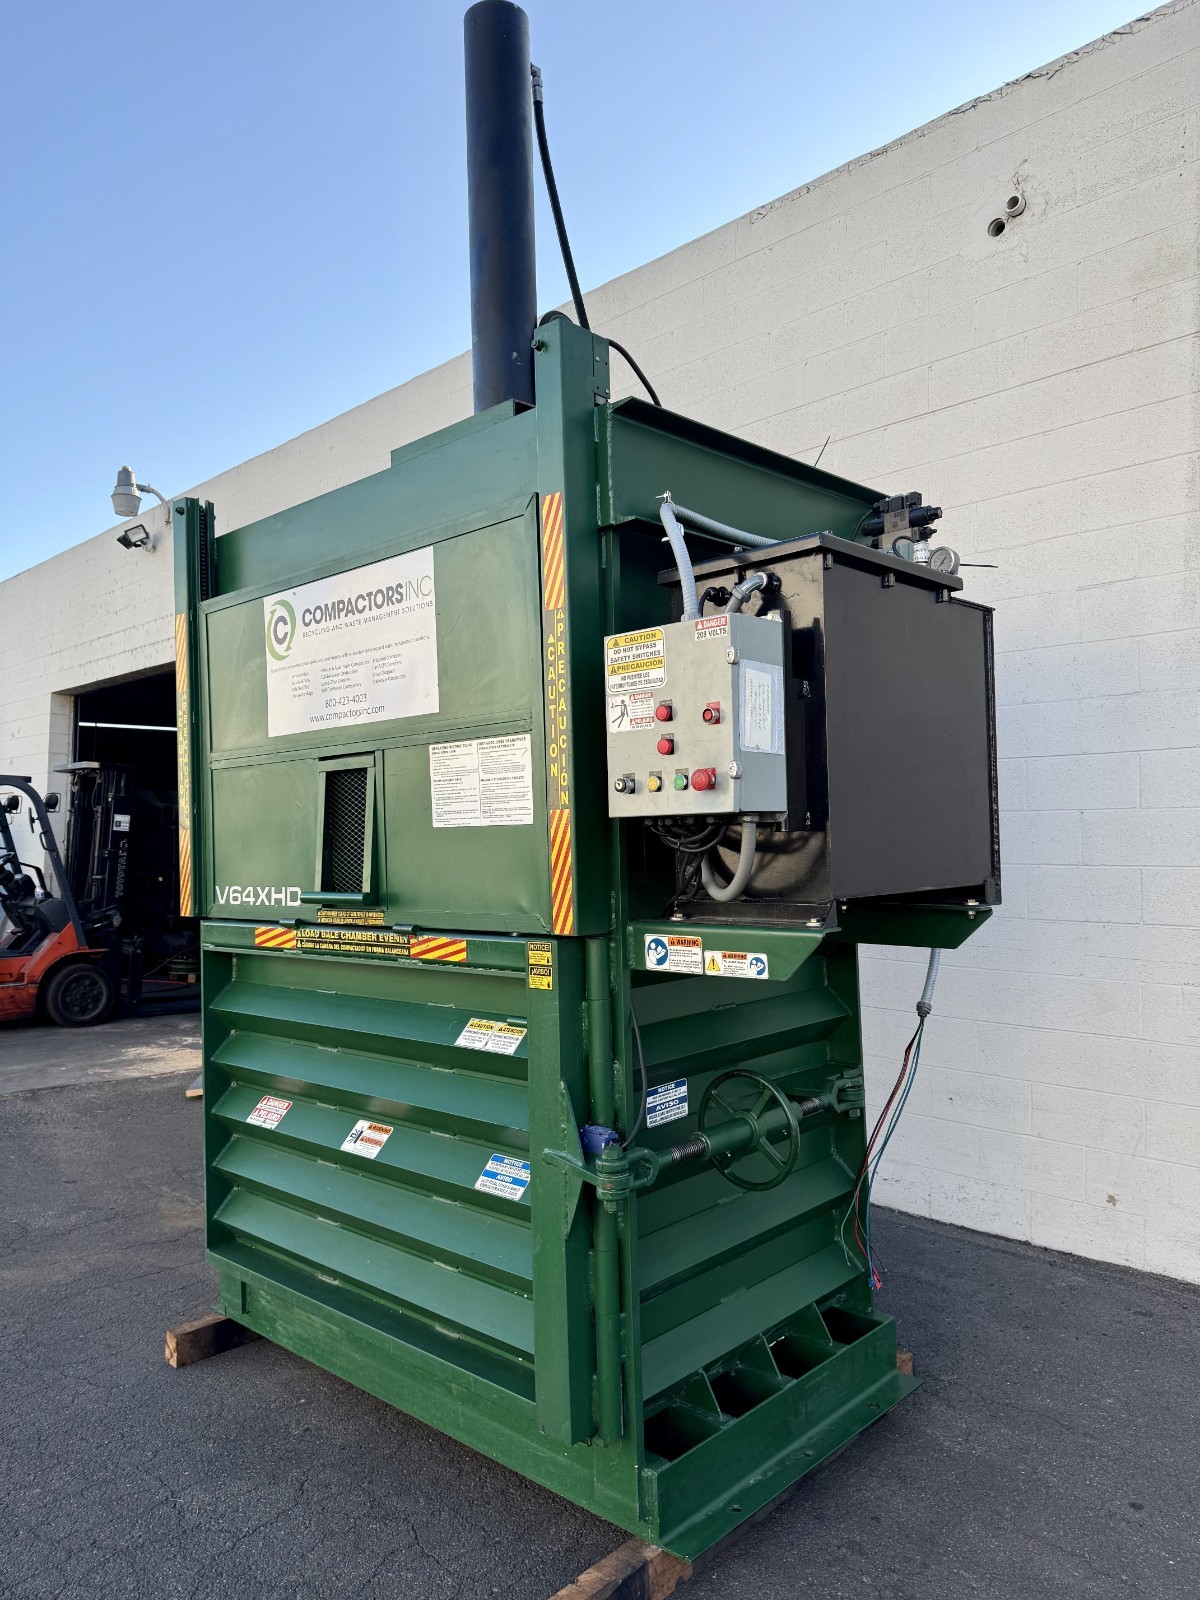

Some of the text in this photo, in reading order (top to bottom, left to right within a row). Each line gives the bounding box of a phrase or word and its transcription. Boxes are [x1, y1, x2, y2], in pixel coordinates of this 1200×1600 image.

[302, 600, 434, 639] RECYCLING AND WASTE MANAGEMENT SOLUTIONS
[624, 632, 657, 644] CAUTION
[708, 627, 727, 637] VOLTS
[622, 645, 634, 653] NOT
[635, 642, 657, 651] BYPASS
[610, 650, 661, 664] SAFETY SWITCHES
[617, 657, 663, 672] PRECAUCIÓN
[326, 693, 368, 708] 800-423-4003
[310, 705, 385, 723] www.compactorsinc.com
[547, 646, 558, 777] CAUTION
[557, 622, 569, 805] PRECAUCIÓN
[114, 856, 127, 898] TOYOTA
[215, 885, 302, 907] V64XHD
[301, 929, 320, 938] LOAD
[321, 931, 339, 939] BALE
[341, 931, 377, 942] CHAMBER
[676, 938, 699, 947] WARNING
[474, 1022, 494, 1030] CAUTION
[658, 1083, 676, 1093] NOTICE
[267, 1098, 289, 1110] DANGER
[656, 1099, 679, 1111] AVISO
[259, 1109, 281, 1121] PELIGRO
[503, 1158, 524, 1168] NOTICE
[496, 1174, 513, 1183] AVISO
